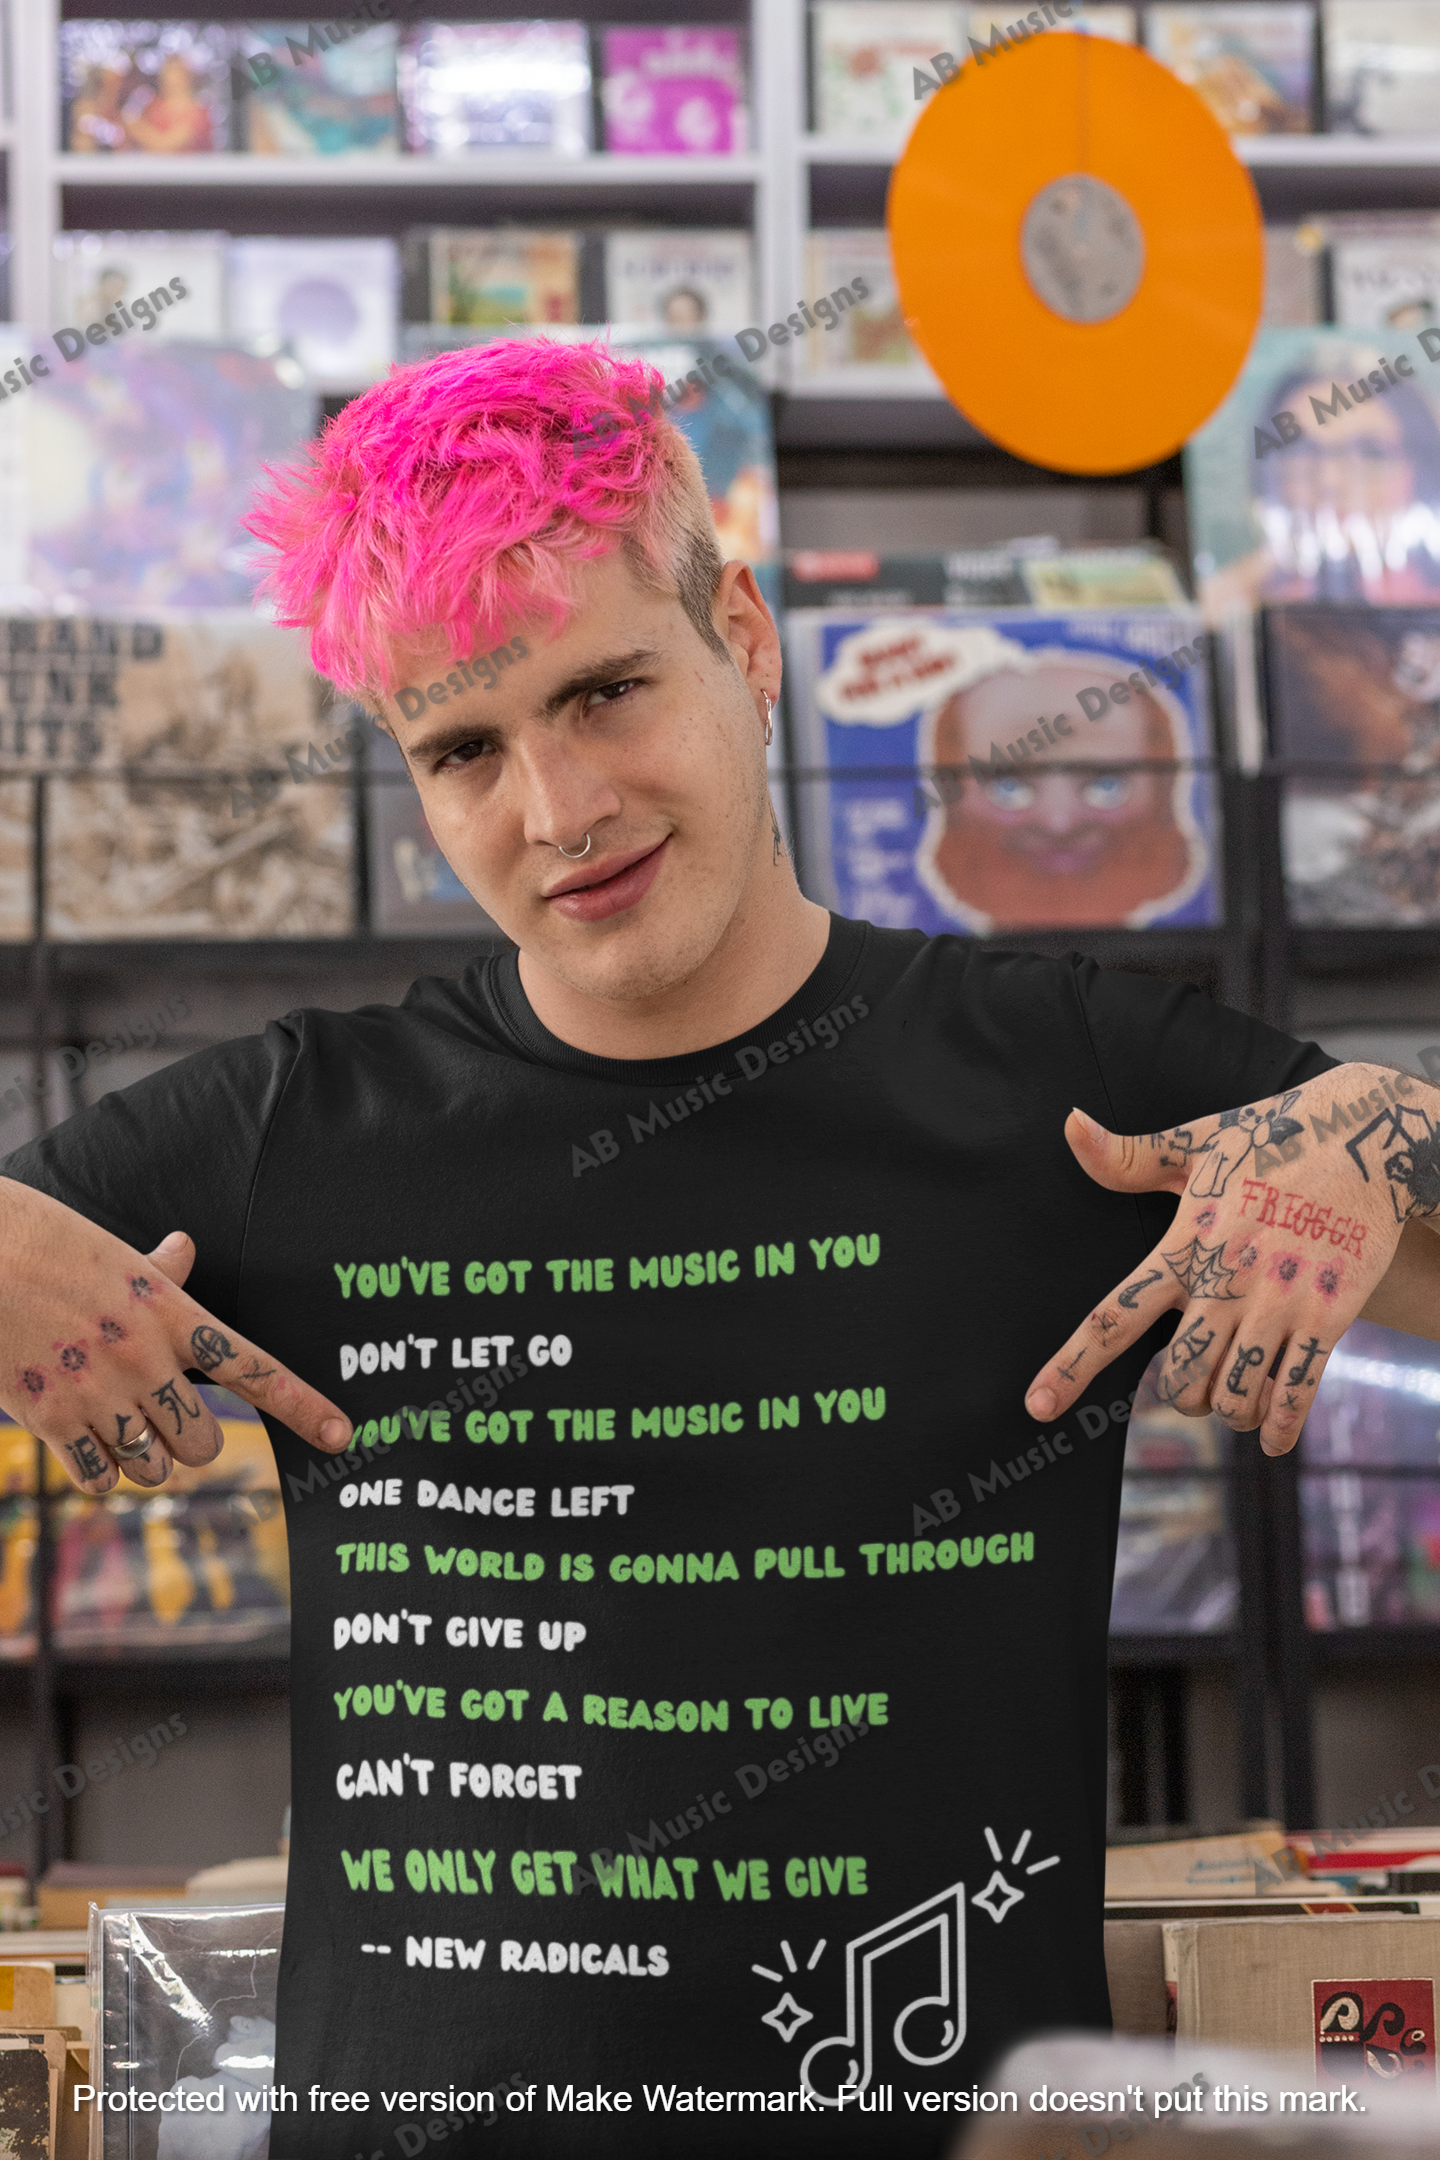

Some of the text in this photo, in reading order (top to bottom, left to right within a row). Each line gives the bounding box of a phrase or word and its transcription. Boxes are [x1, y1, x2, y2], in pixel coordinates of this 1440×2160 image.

[334, 1233, 881, 1299] YOU'VE GOT THE MUSIC IN YOU
[339, 1333, 573, 1381] DON'T LET GO
[465, 1410, 534, 1444] GOT
[547, 1408, 616, 1442] THE
[631, 1402, 744, 1439] MUSIC
[759, 1395, 800, 1430] IN
[814, 1386, 886, 1424] YOU
[339, 1478, 635, 1518] ONE DANCE LEFT
[335, 1531, 1034, 1584] THIS WORLD IS GONNA PULL THROUGH
[333, 1608, 587, 1652] DON'T GIVE UP
[333, 1679, 889, 1733] YOU'VE GOT A REASON TO LIVE
[336, 1752, 583, 1801] CAN'T FORGET
[341, 1848, 868, 1901] WE ONLY GET WHAT WE GIVE
[405, 1935, 487, 1971] NEW
[500, 1939, 670, 1977] RADICALS
